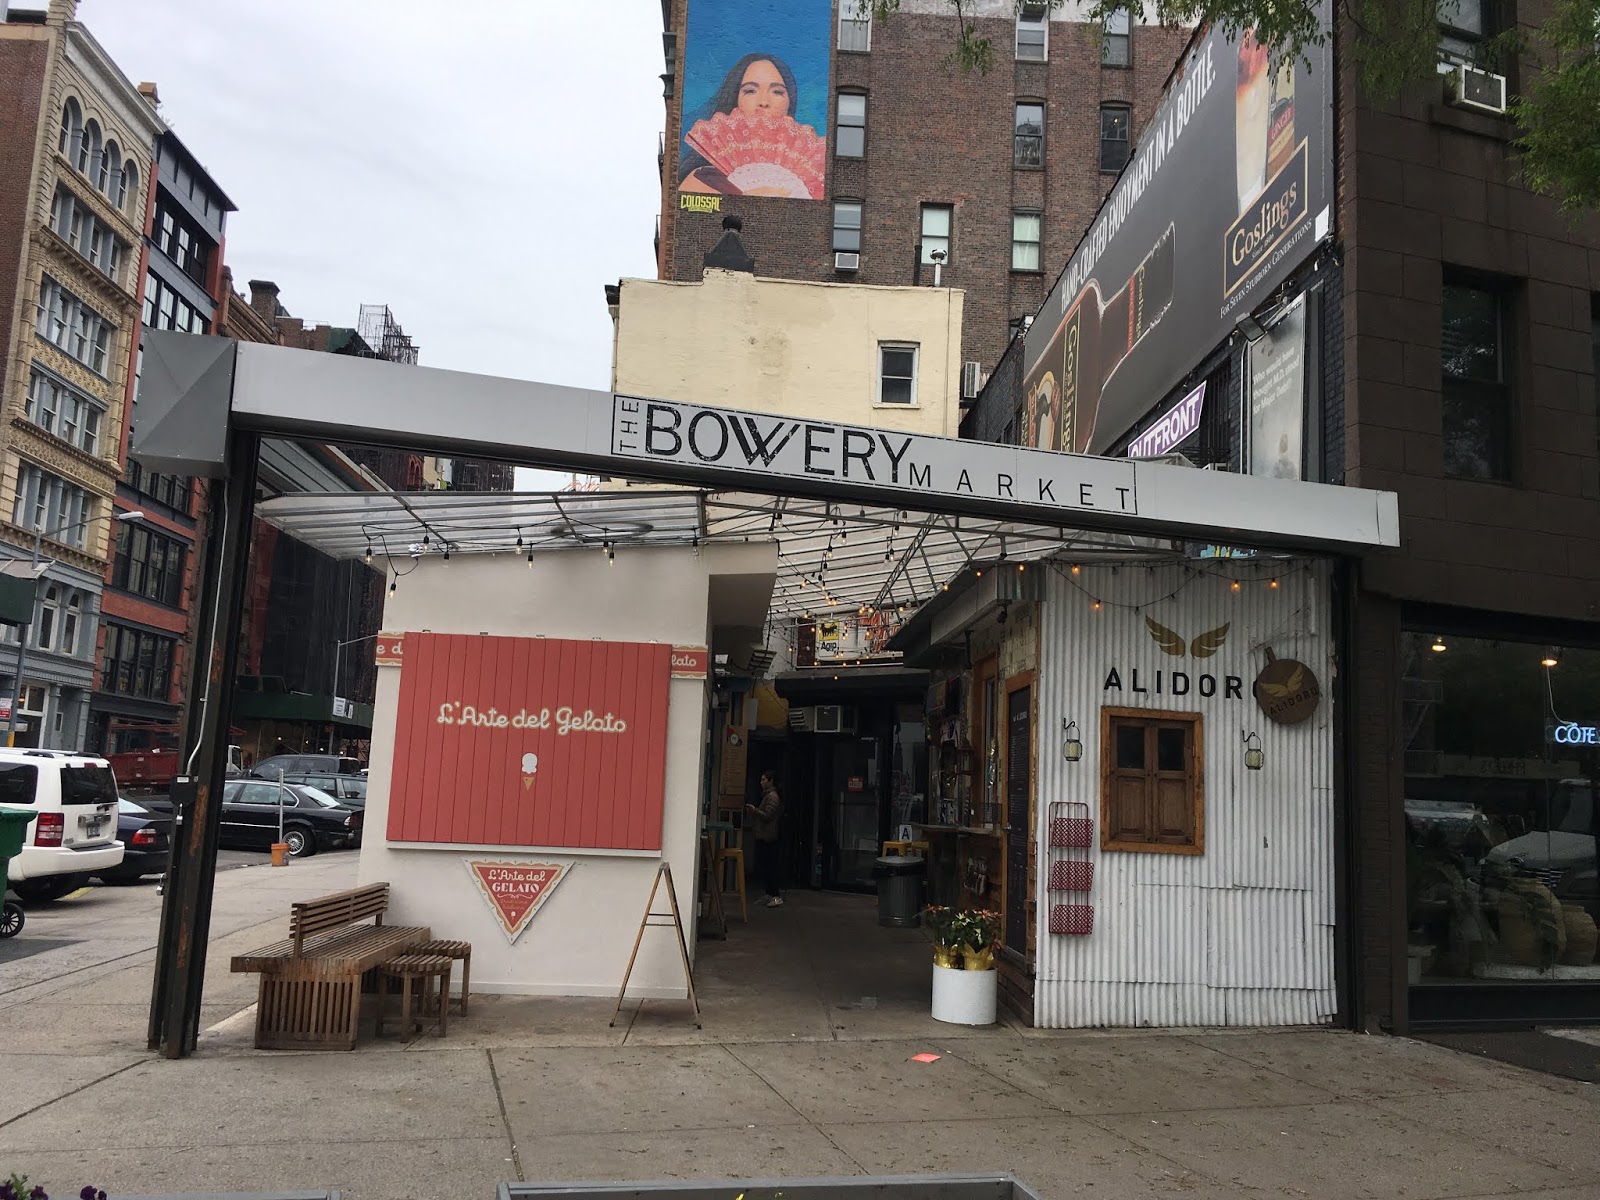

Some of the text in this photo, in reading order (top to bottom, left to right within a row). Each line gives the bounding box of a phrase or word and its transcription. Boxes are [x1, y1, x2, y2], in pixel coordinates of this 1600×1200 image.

[681, 194, 720, 211] COLOSSAL
[1061, 216, 1106, 314] HAND-CRAFTED
[1109, 140, 1156, 242] ENJOYMENT
[1154, 125, 1167, 173] IN
[1167, 108, 1174, 155] A
[1232, 181, 1297, 267] Goslings
[1062, 325, 1077, 452] Goslings
[619, 399, 1131, 511] THE BOWERY MARKET
[820, 641, 837, 653] Agip
[1103, 667, 1257, 700] ALIDOR
[1270, 686, 1319, 715] ALIDORO
[437, 700, 627, 736] L'Arte del Gelato
[901, 827, 910, 840] A
[487, 869, 545, 881] L'Arte del
[491, 882, 539, 893] GELATO
